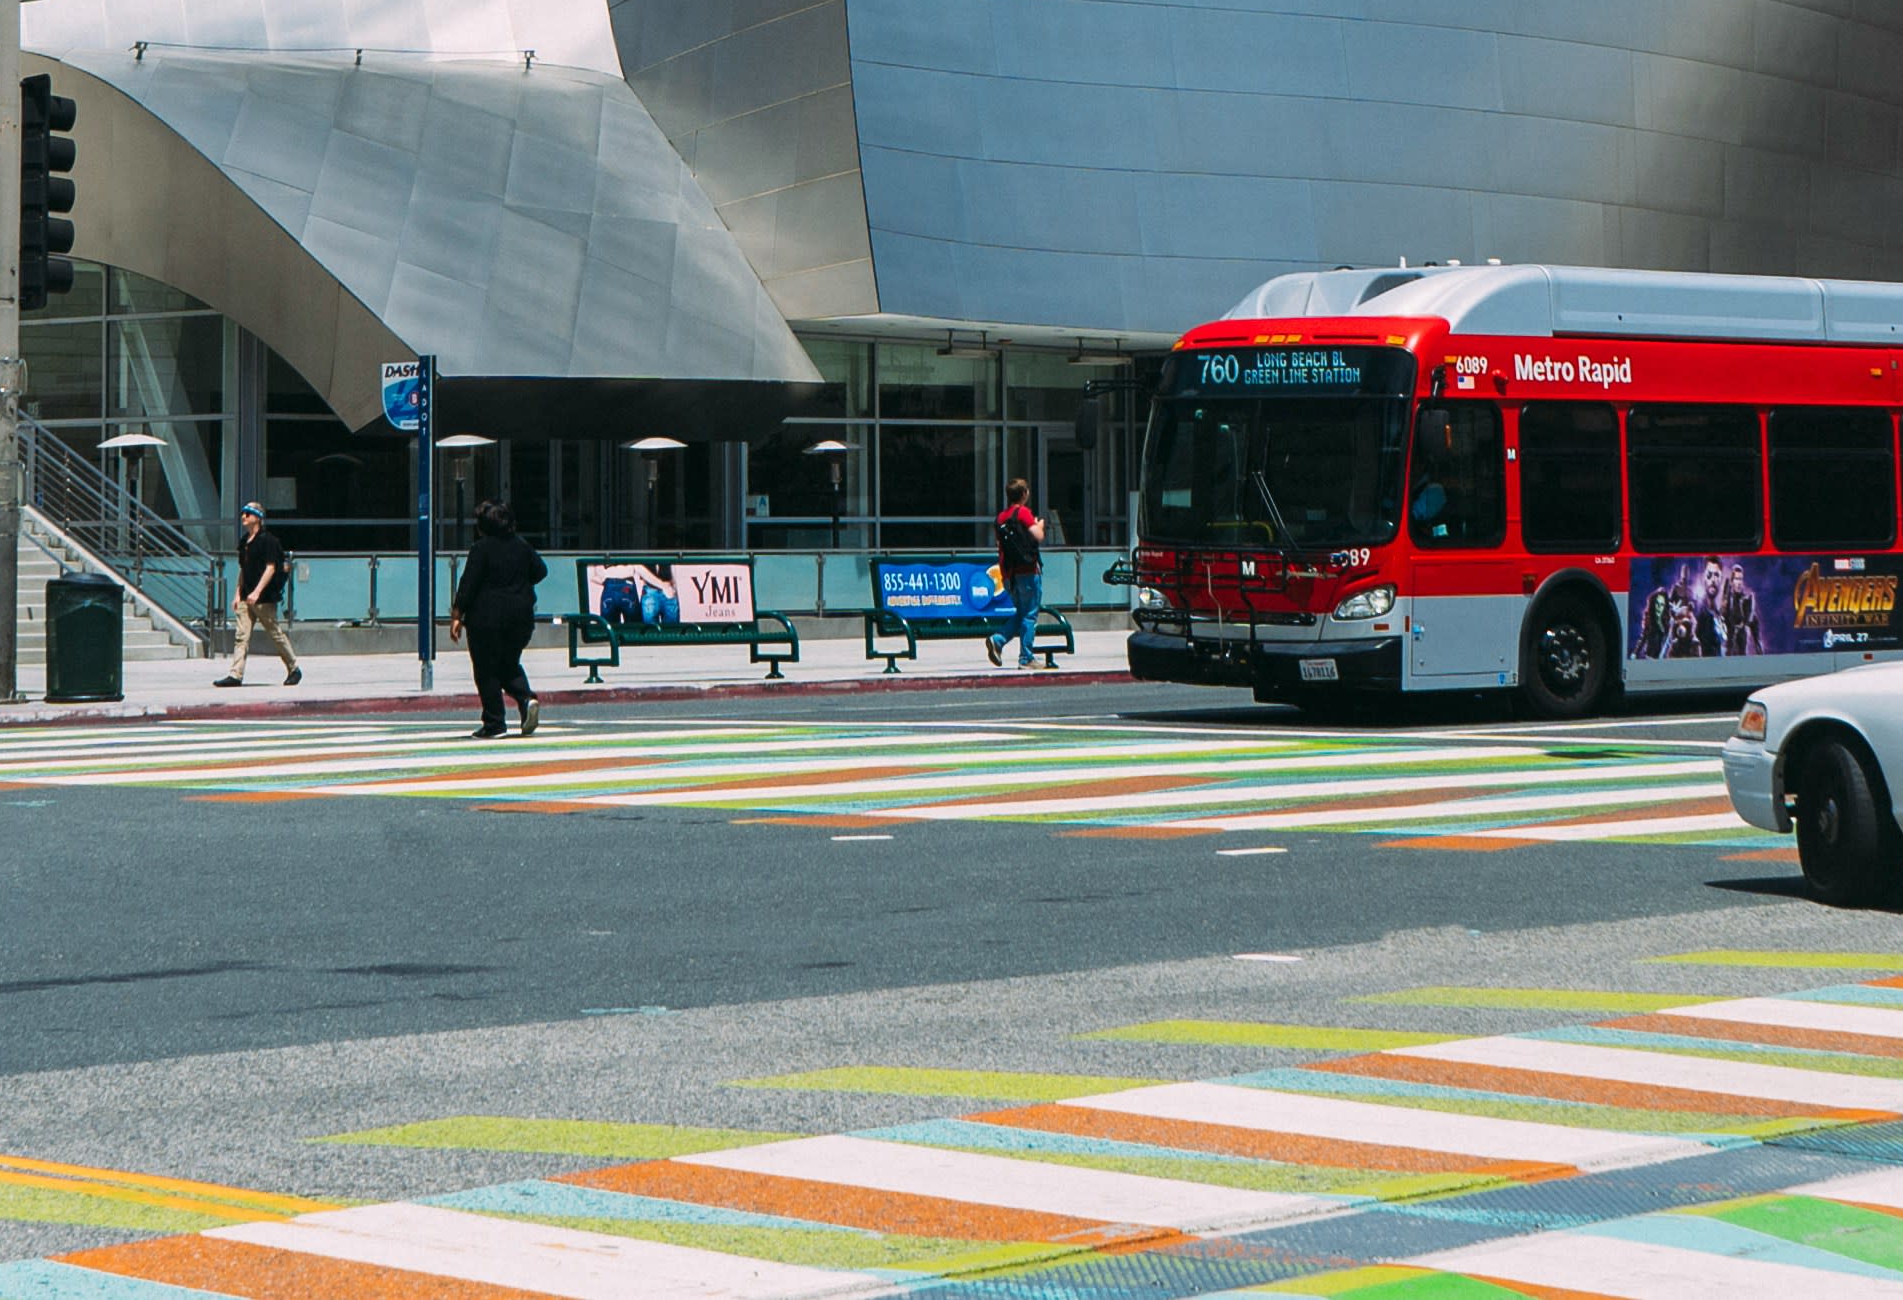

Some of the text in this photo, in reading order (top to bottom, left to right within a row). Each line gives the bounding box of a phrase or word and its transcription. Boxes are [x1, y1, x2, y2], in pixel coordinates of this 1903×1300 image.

[1256, 351, 1347, 367] LONG BEACH BL
[1456, 356, 1488, 374] 6089
[385, 364, 420, 378] DASH
[1198, 354, 1239, 384] 760
[1244, 367, 1361, 384] GREEN LINE STATION
[1514, 354, 1632, 389] Metro Rapid
[1242, 560, 1256, 576] M
[691, 570, 740, 604] YMI
[884, 572, 961, 591] 855-441-1300
[1793, 561, 1898, 629] AVENGERS
[705, 605, 736, 617] Jeans
